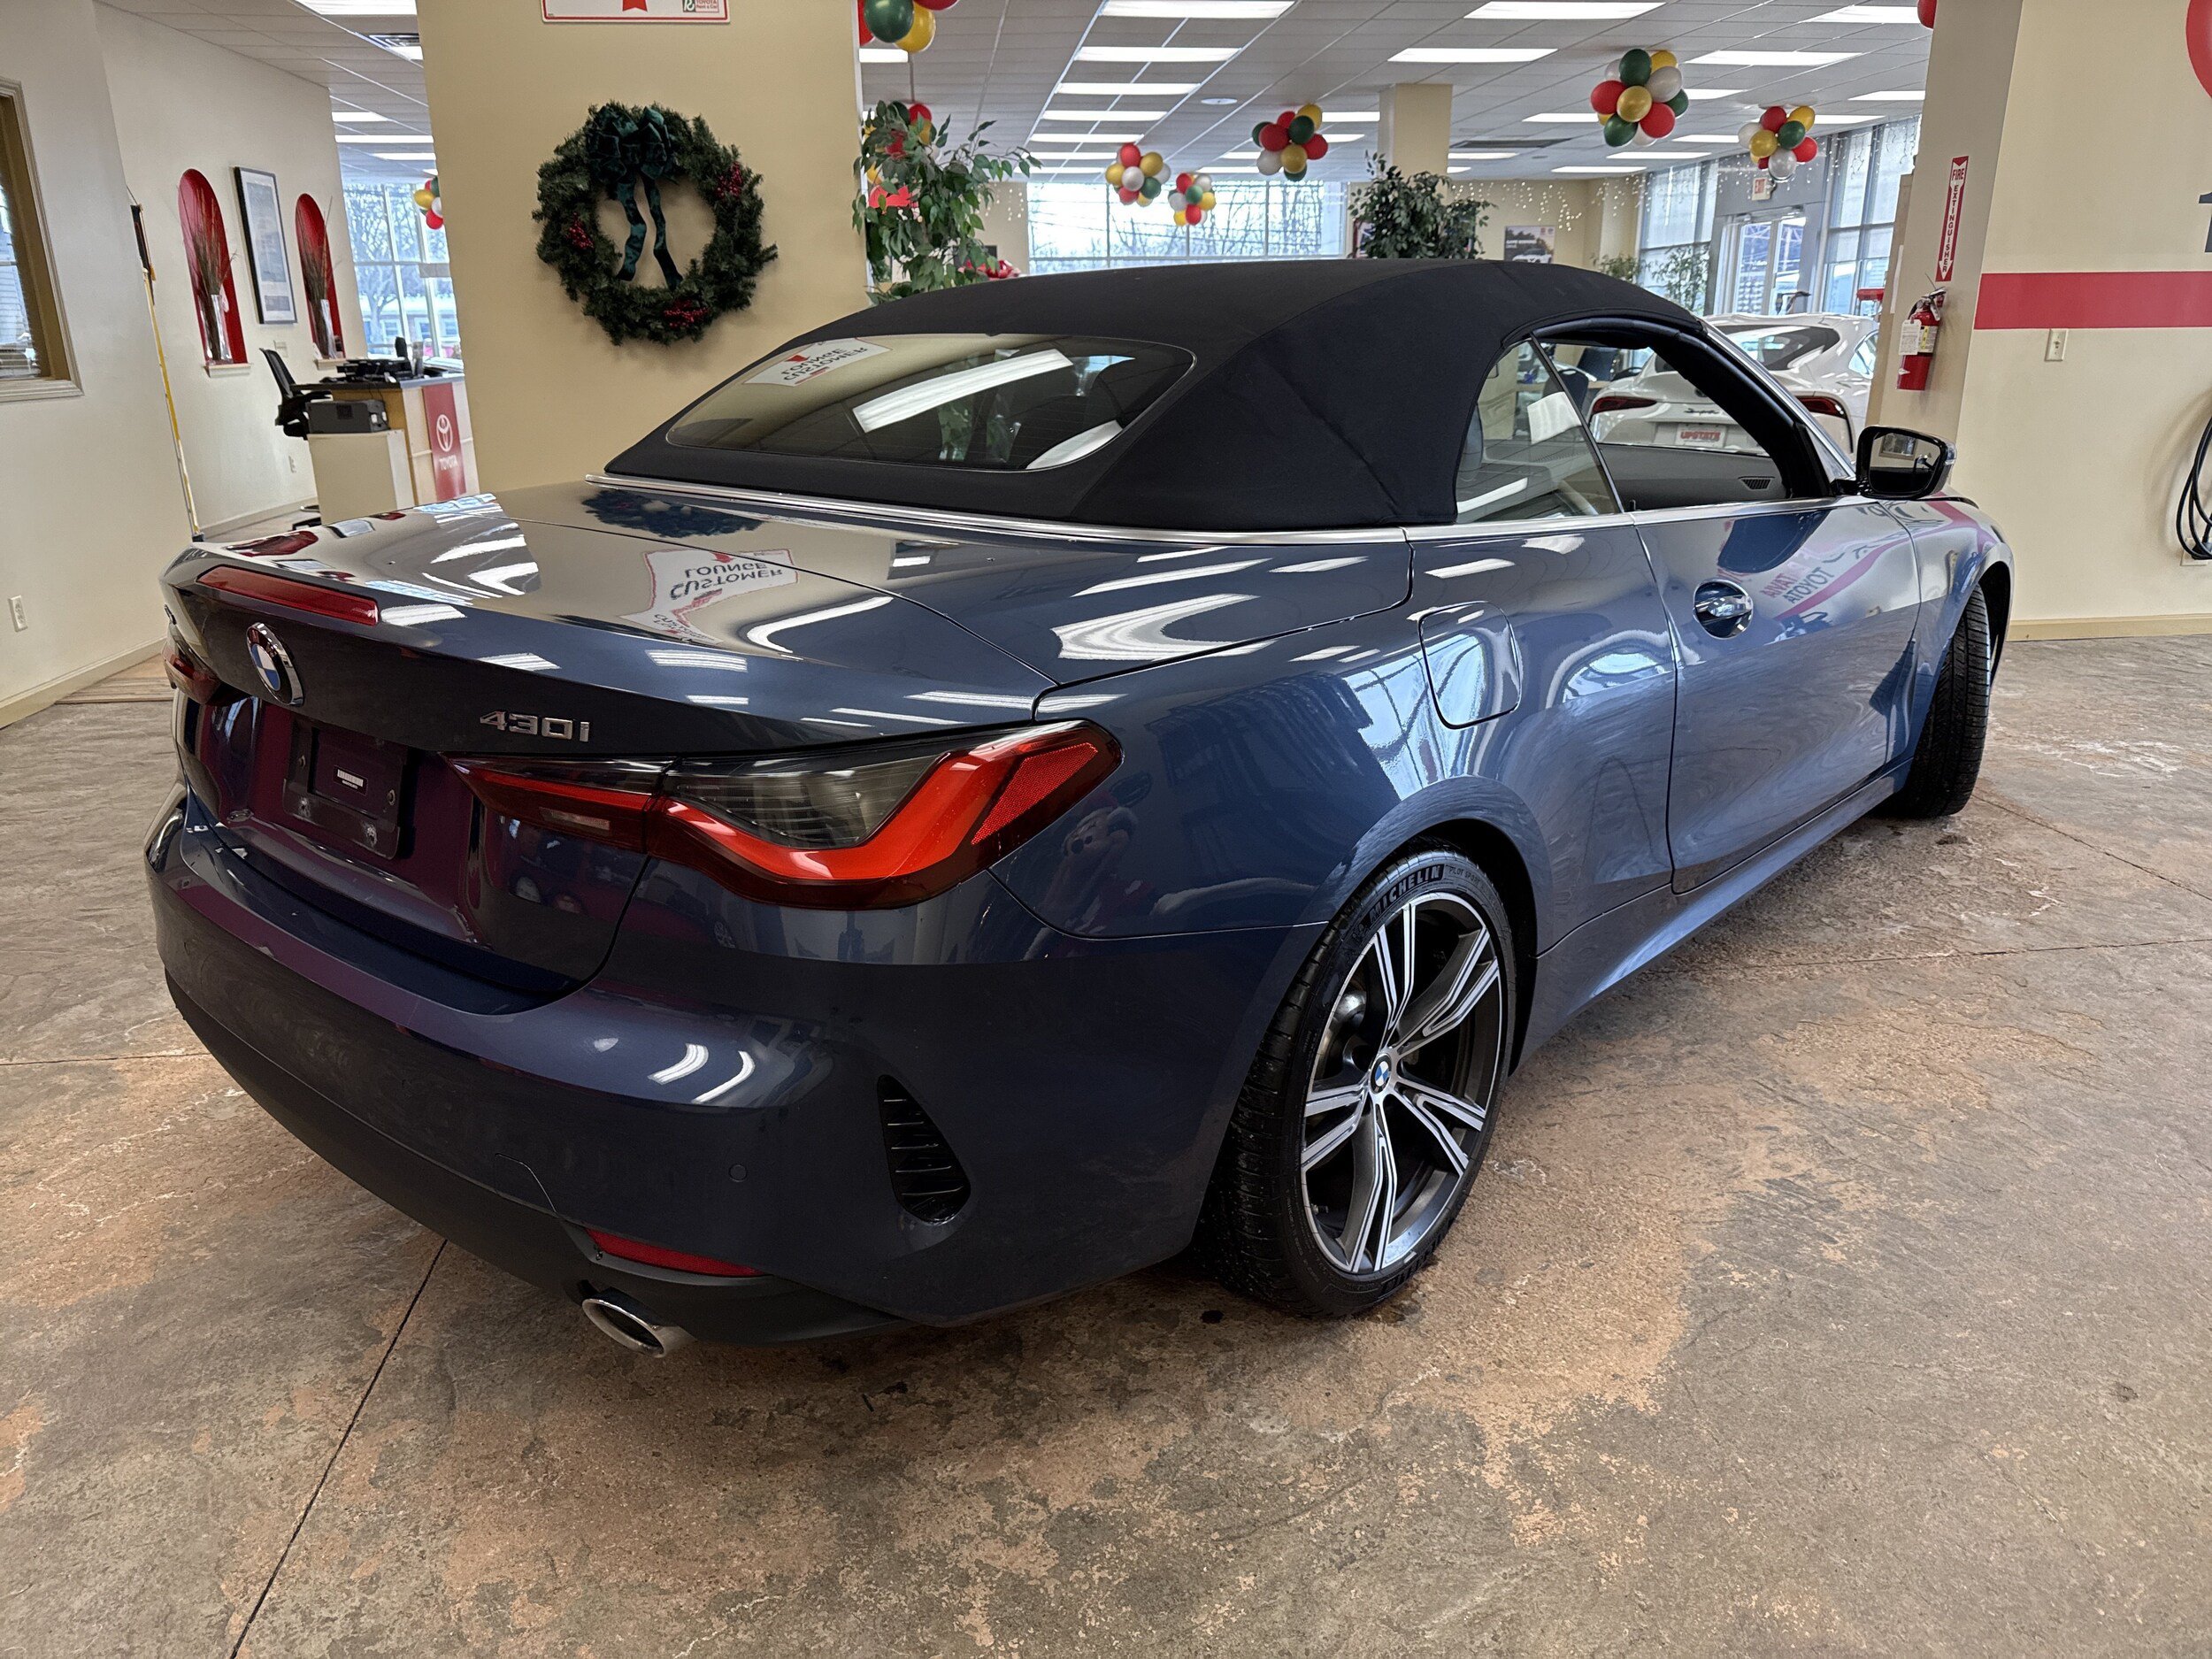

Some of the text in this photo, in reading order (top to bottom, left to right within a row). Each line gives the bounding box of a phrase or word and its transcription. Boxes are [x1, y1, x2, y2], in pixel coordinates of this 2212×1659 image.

[1952, 168, 1965, 180] FIRE
[1942, 184, 1959, 273] EXTINGUISHER
[480, 710, 590, 742] 430i
[1371, 864, 1443, 920] MICHELIN
[1448, 866, 1463, 876] PILOT
